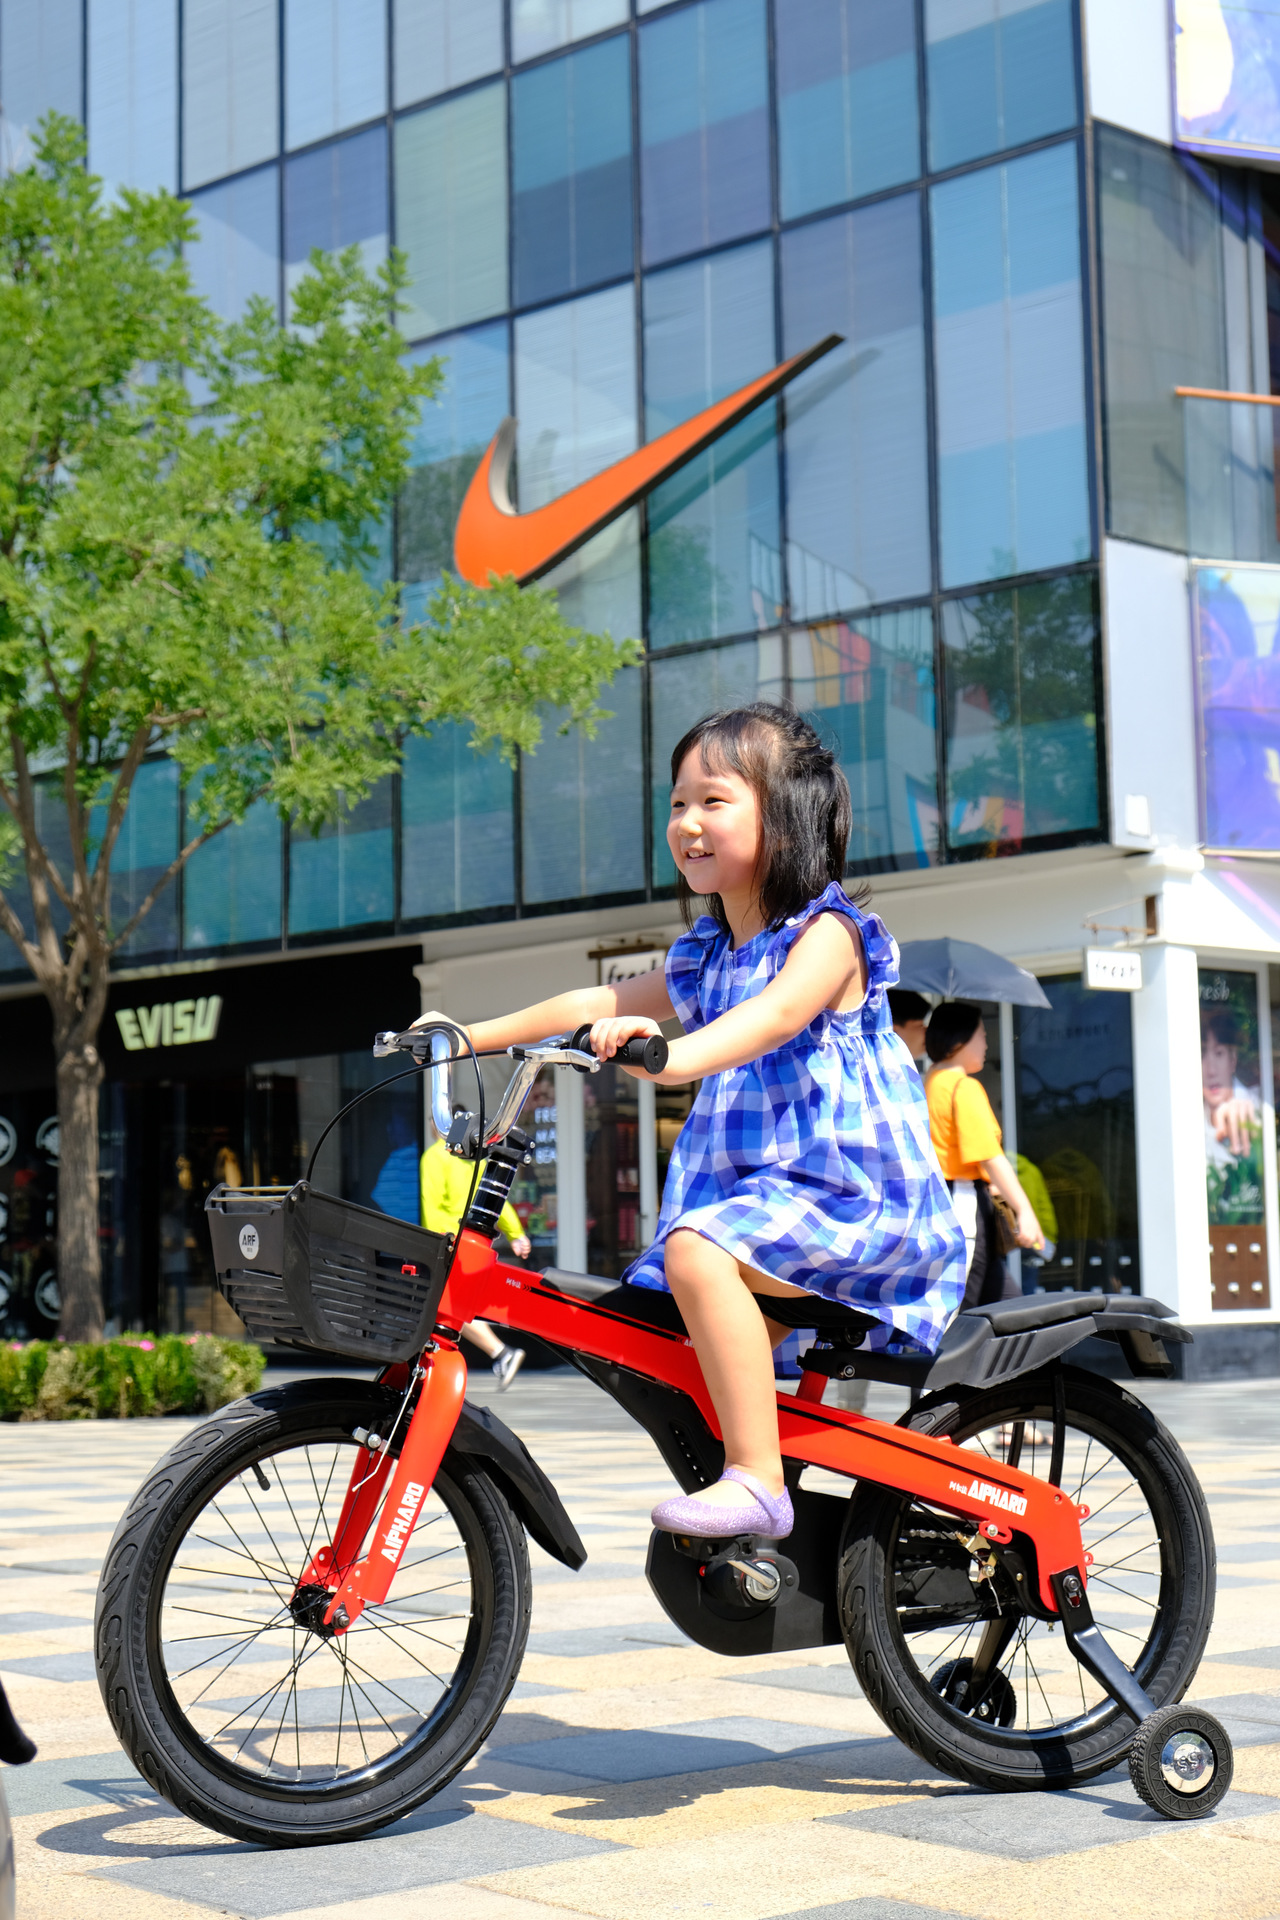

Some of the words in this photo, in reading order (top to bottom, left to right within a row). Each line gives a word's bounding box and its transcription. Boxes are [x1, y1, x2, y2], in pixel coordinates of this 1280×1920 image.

[1199, 979, 1230, 1001] resh
[115, 994, 223, 1051] EVISU
[242, 1235, 256, 1246] ARF
